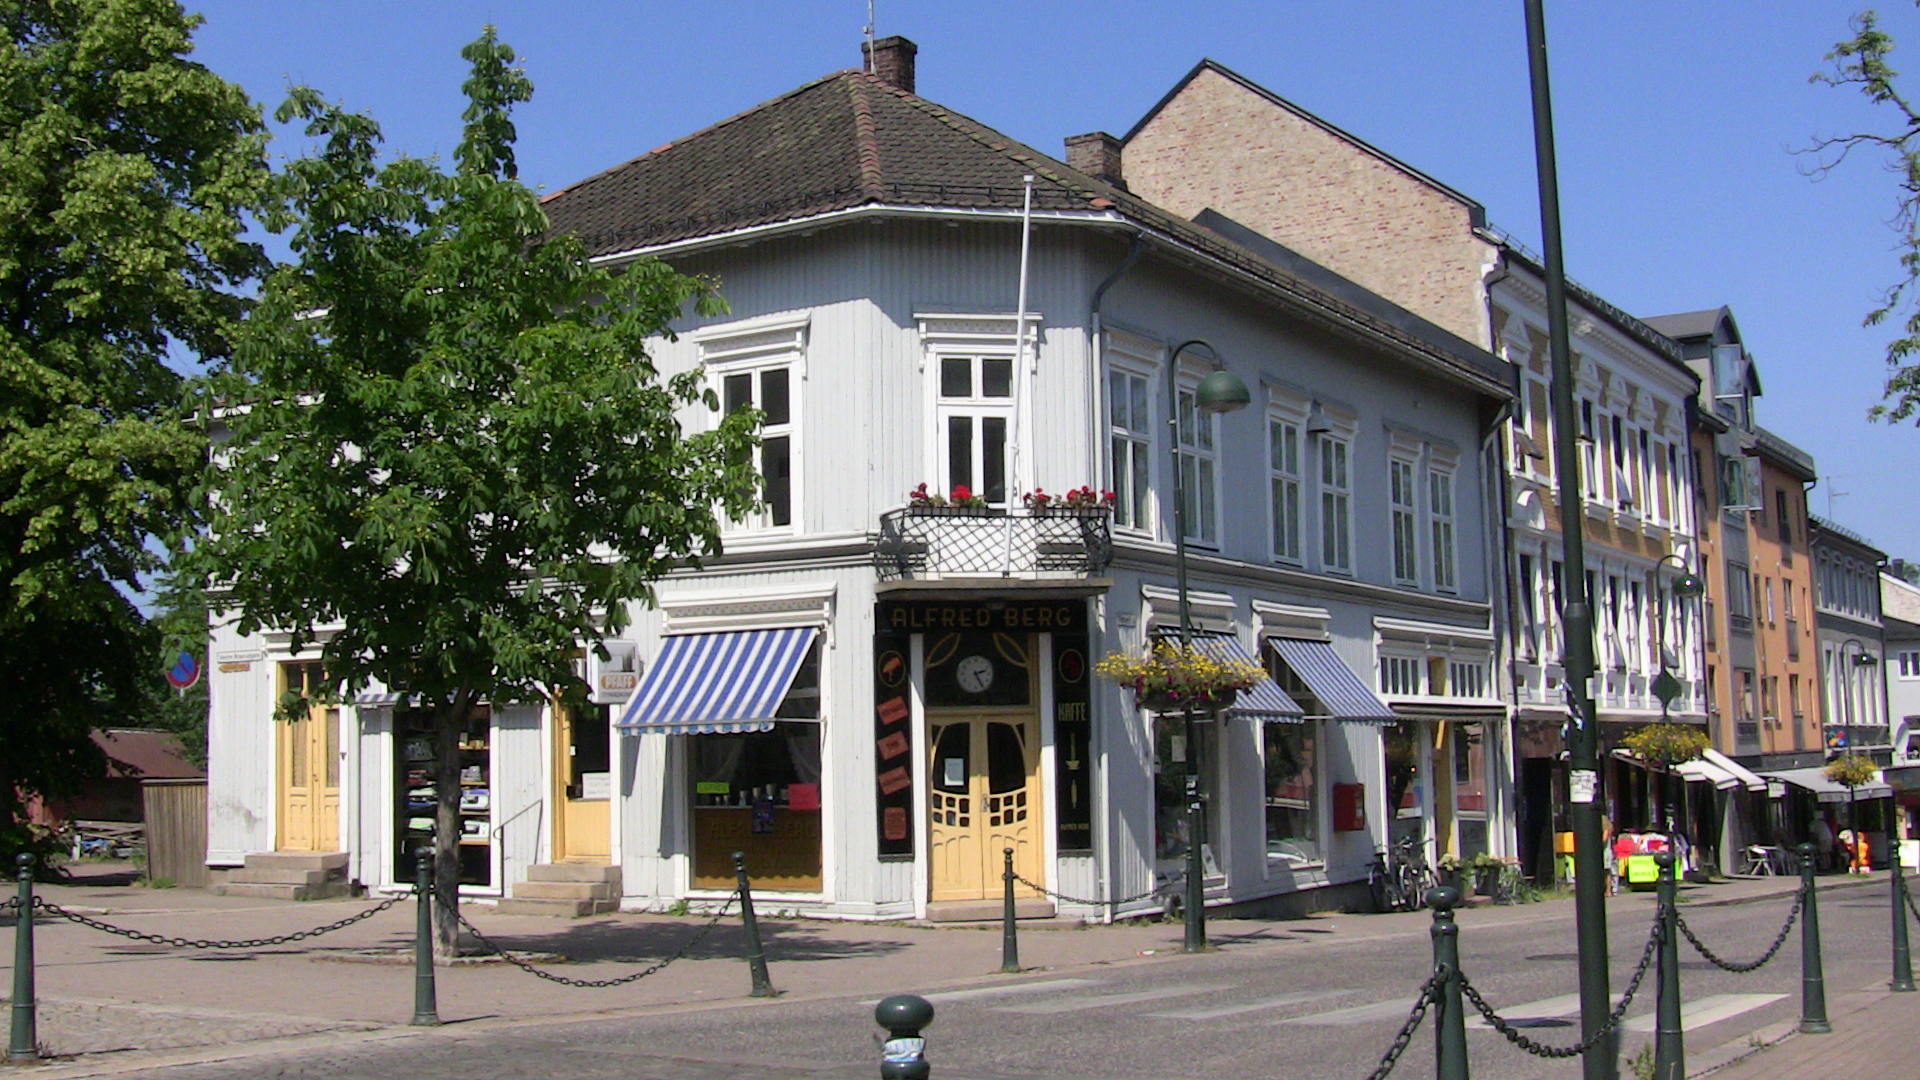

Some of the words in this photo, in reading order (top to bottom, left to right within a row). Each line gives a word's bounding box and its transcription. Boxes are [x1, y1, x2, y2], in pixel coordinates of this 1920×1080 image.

[890, 607, 991, 627] ALFRED
[1004, 607, 1072, 627] BERG
[605, 675, 632, 689] PFAFF
[1058, 702, 1087, 722] KAFFE
